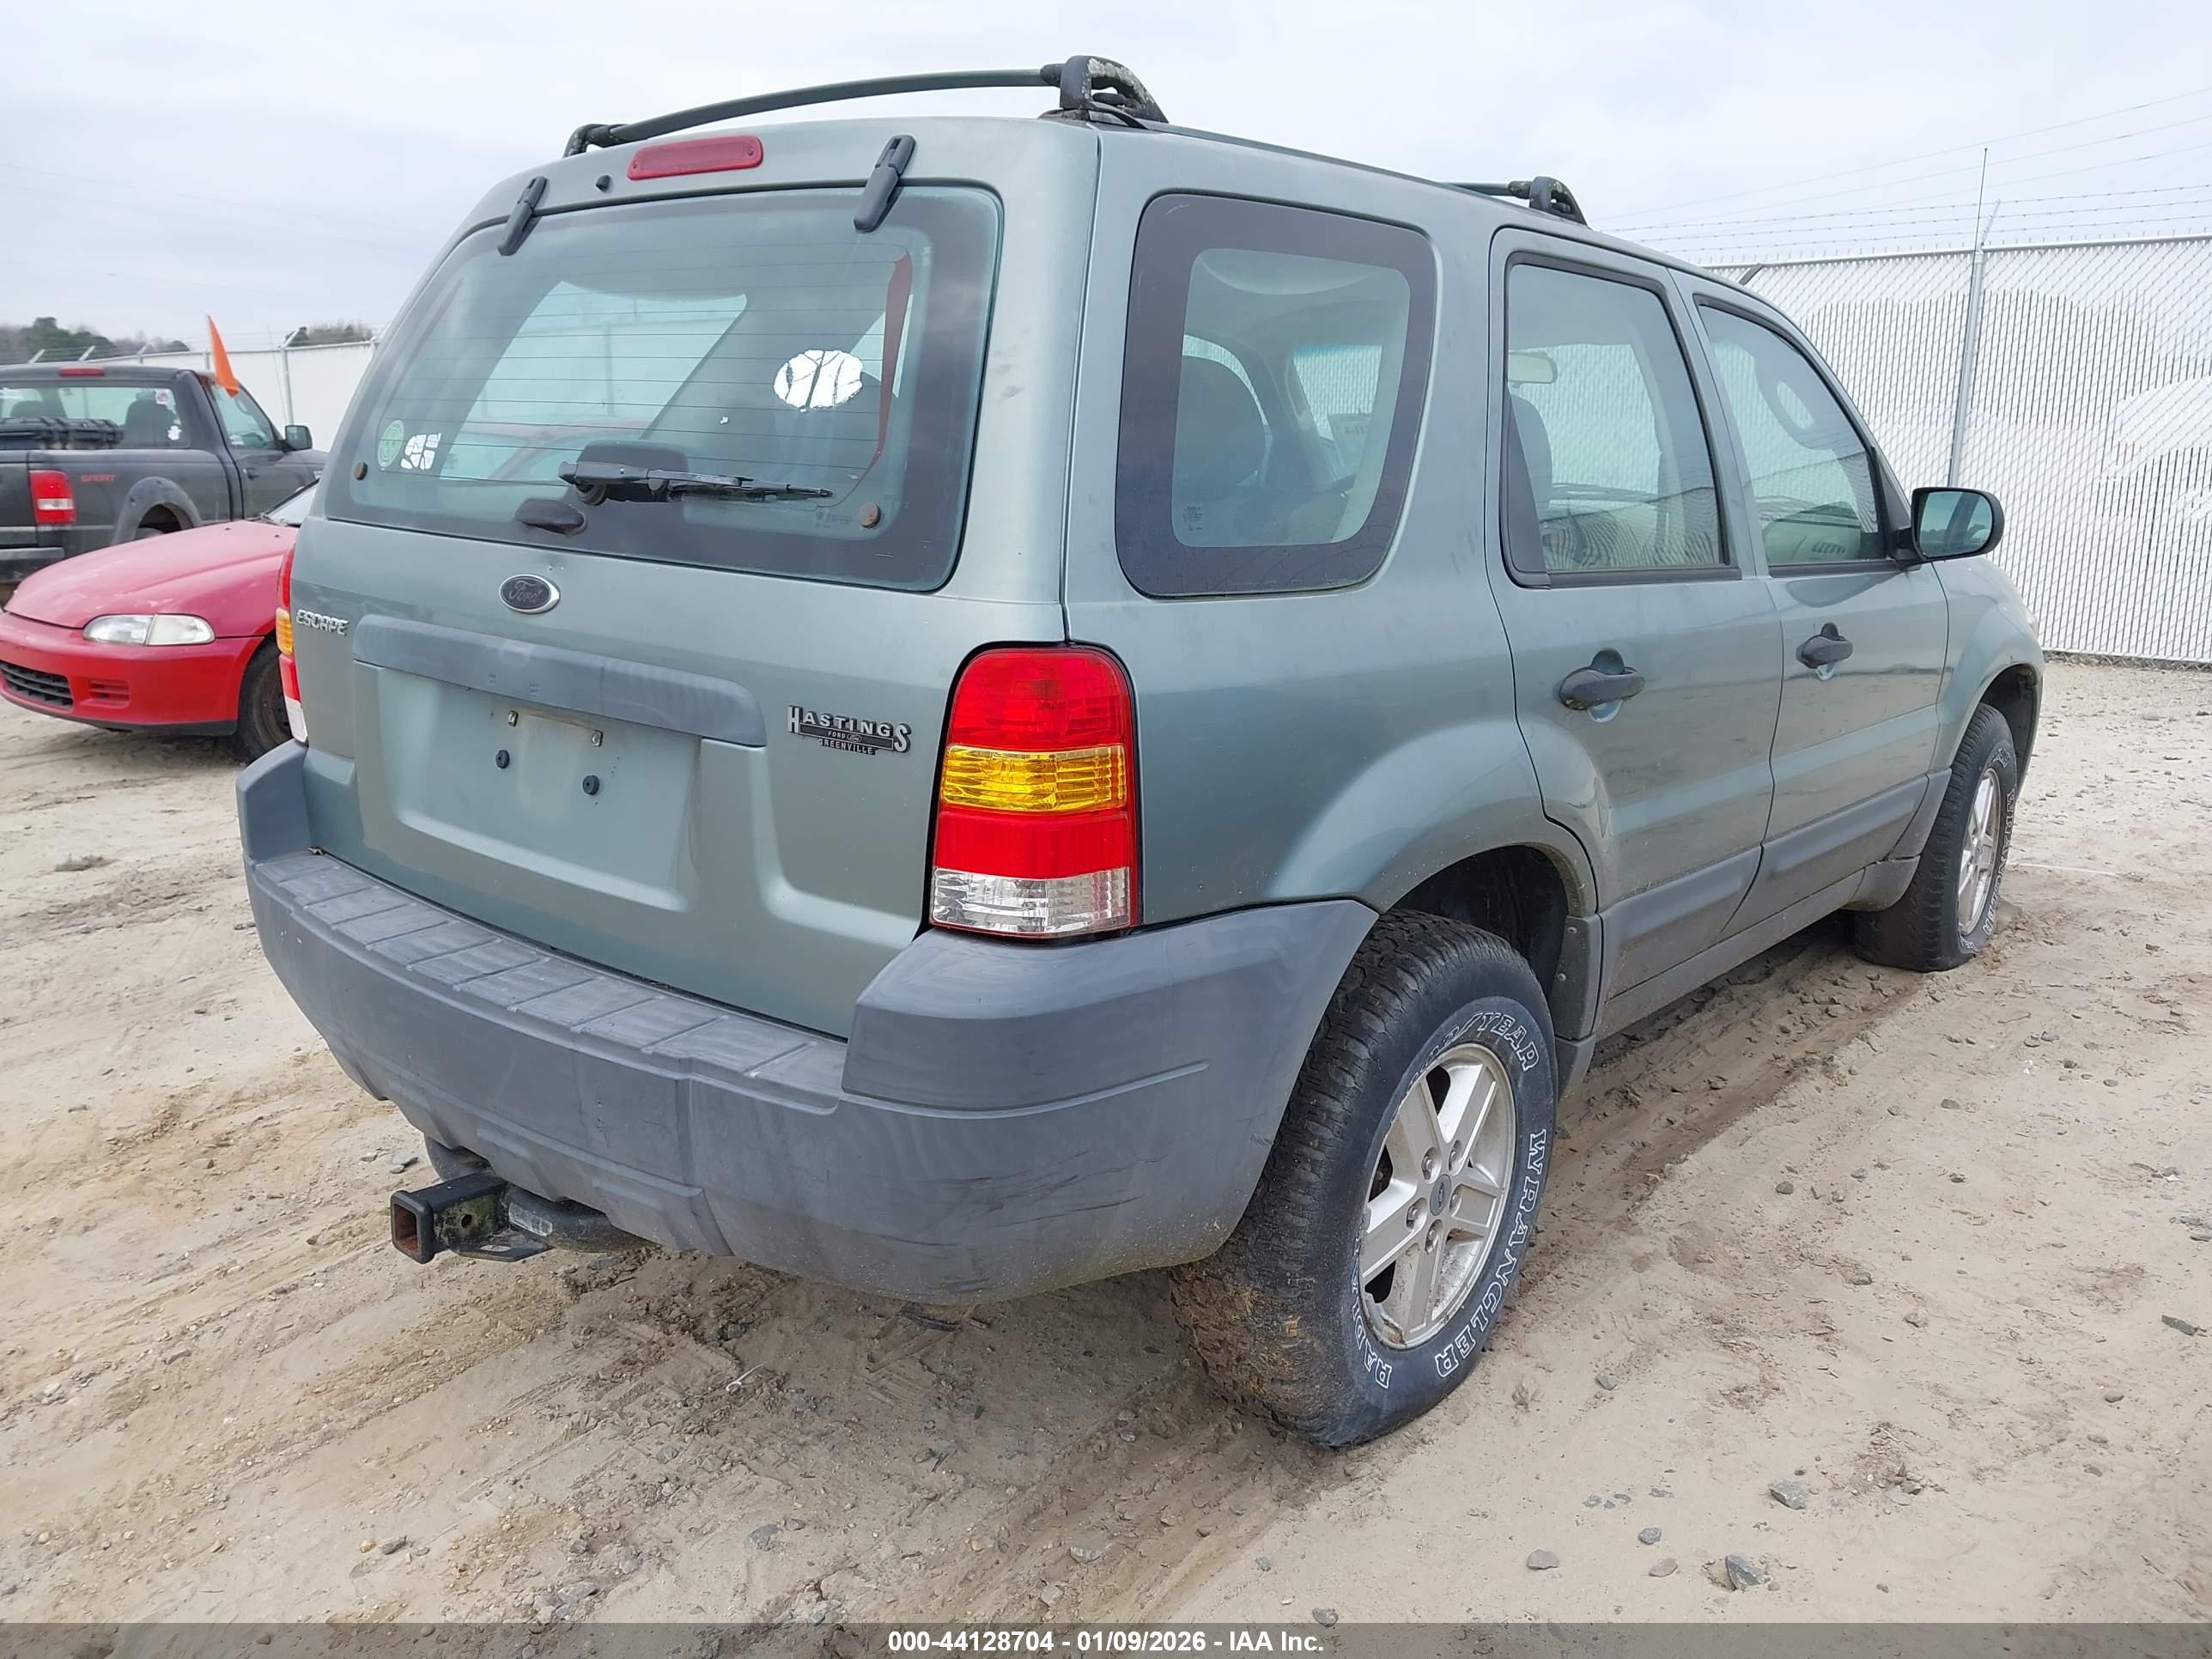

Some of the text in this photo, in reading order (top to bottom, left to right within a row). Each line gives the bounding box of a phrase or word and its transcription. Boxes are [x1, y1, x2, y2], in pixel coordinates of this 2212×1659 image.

[508, 580, 543, 604] Ford
[295, 609, 349, 635] ESCAPE
[787, 704, 912, 753] HASTINGS
[828, 730, 847, 739] FORD
[817, 738, 875, 755] GREENVILLE
[1408, 1012, 1540, 1087] DYEAR
[1435, 1128, 1547, 1377] WRANGLER
